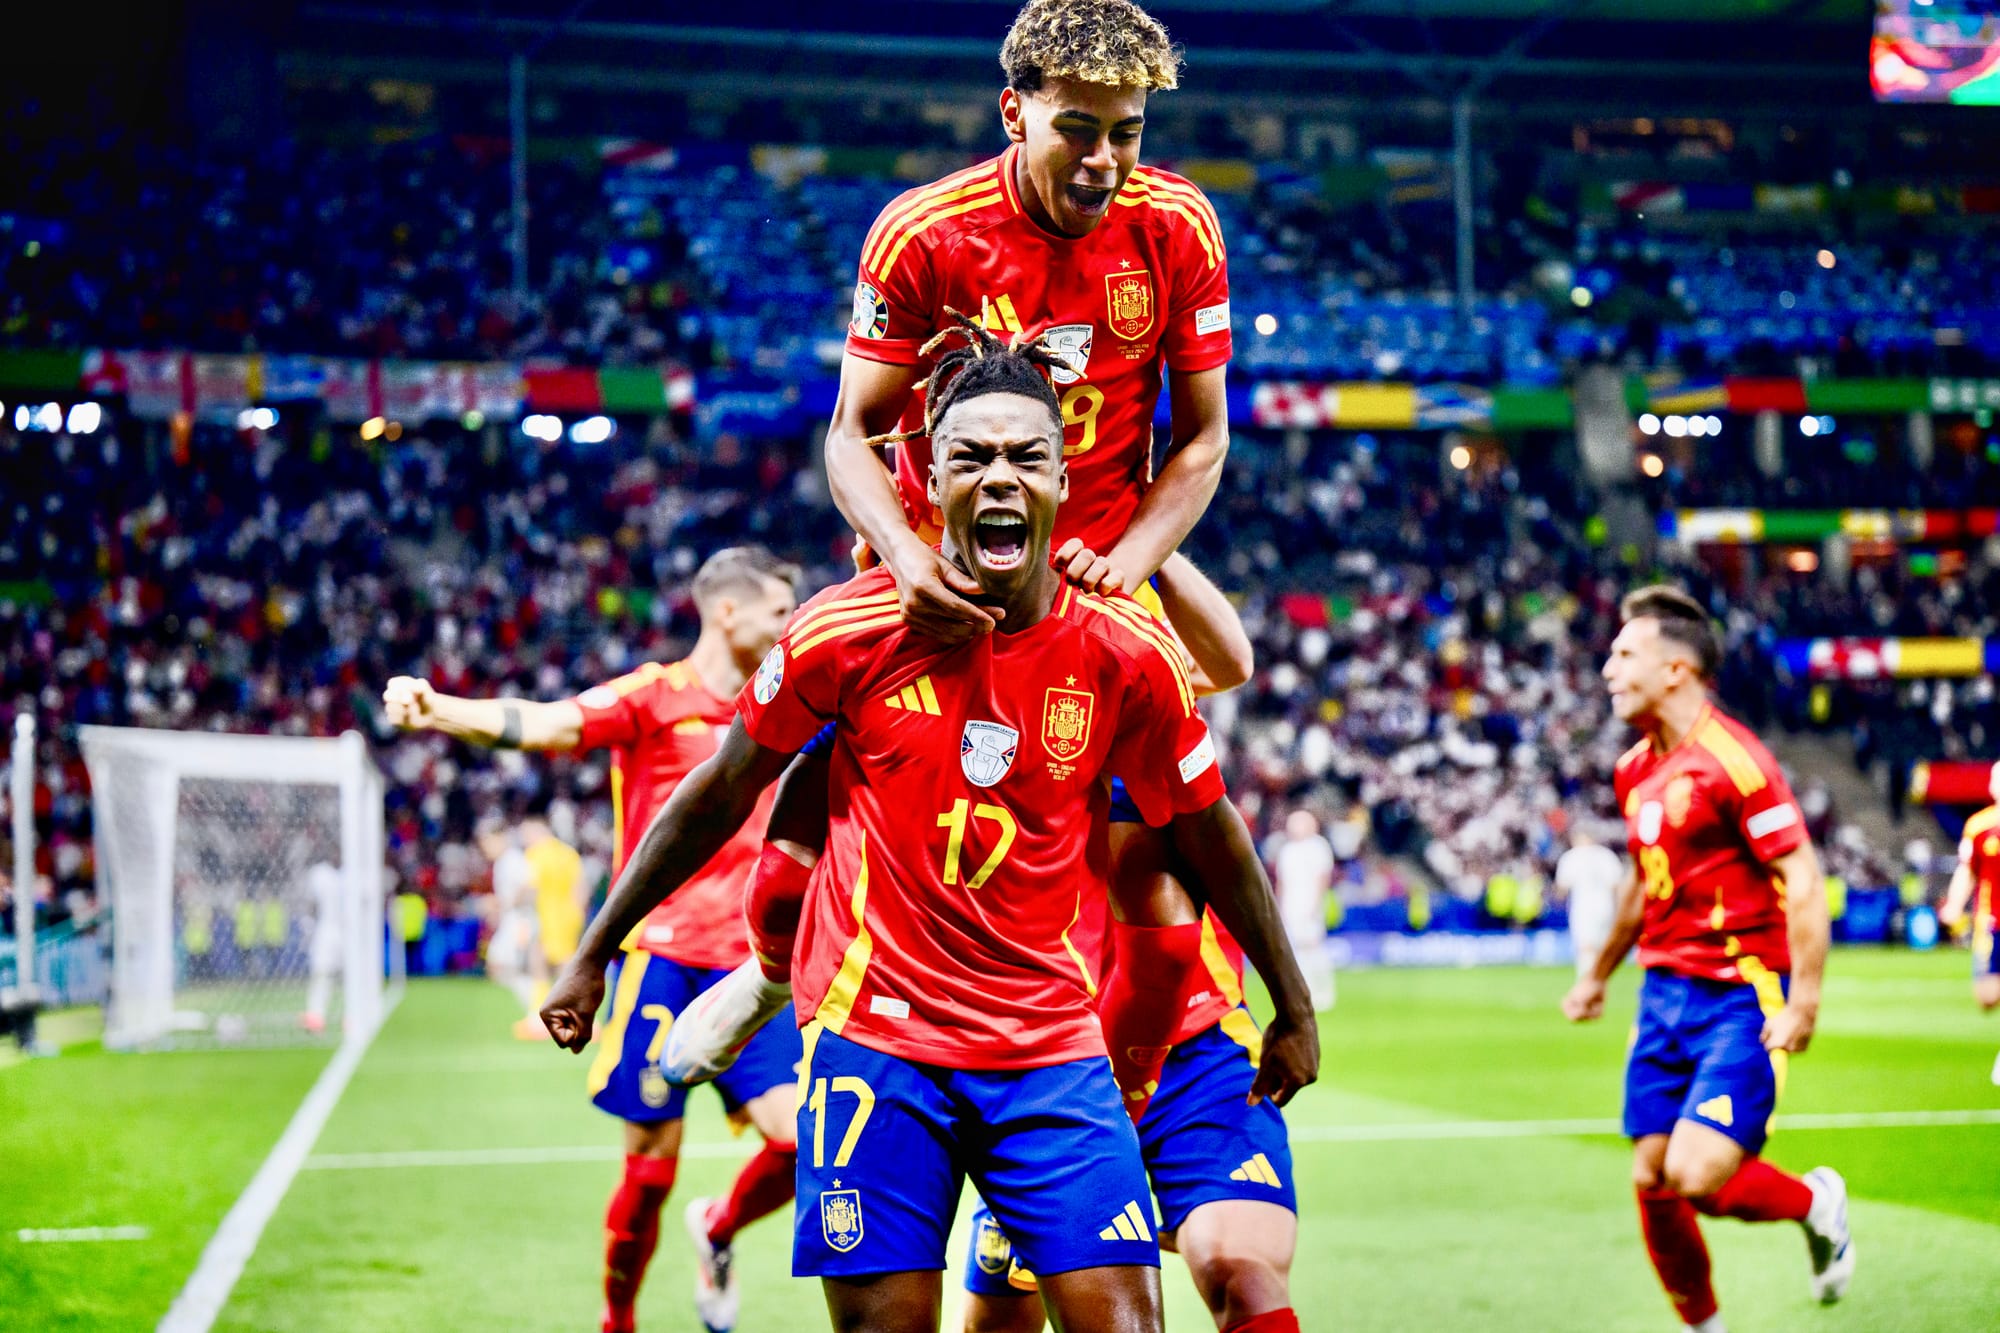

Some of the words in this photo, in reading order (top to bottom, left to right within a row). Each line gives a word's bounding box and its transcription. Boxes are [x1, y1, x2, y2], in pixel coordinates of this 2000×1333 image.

[1061, 384, 1105, 456] 9
[936, 797, 1017, 890] 17
[640, 1003, 675, 1063] 7
[809, 1076, 876, 1168] 17
